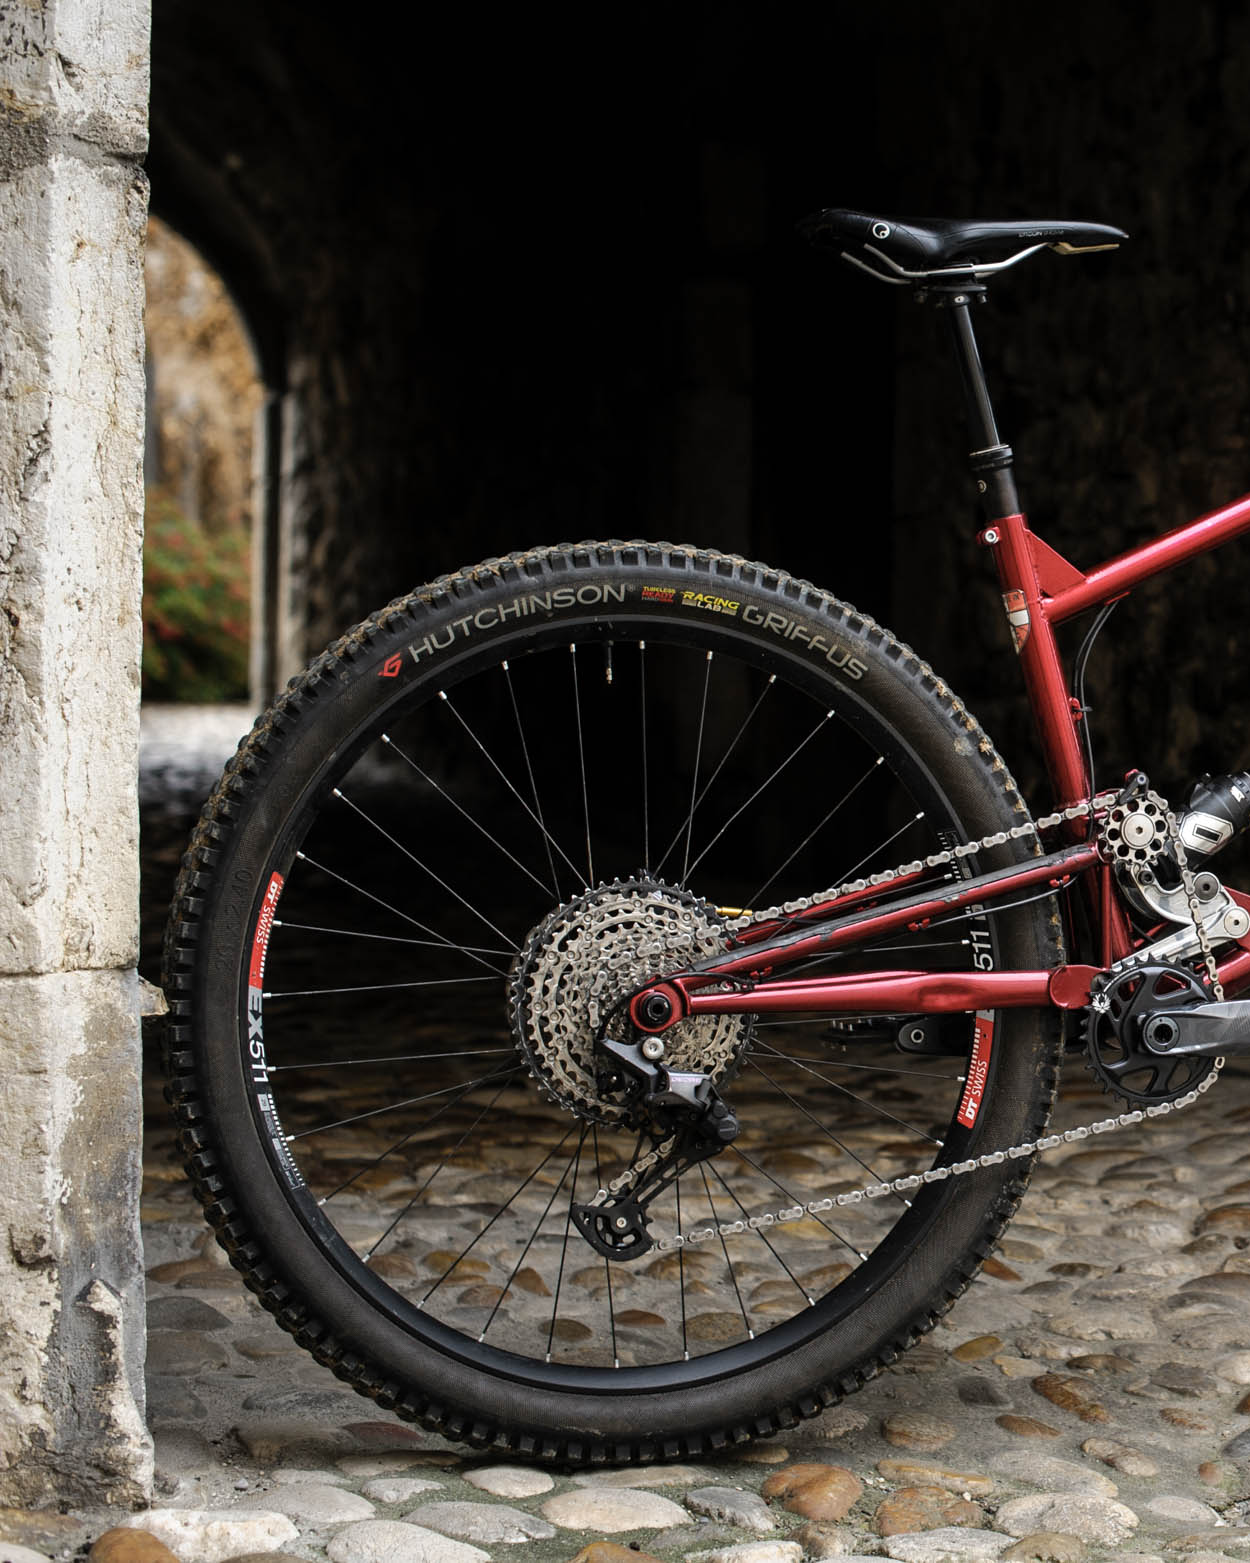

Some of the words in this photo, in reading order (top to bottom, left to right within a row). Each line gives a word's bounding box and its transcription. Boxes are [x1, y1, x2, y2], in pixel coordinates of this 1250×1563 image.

[681, 591, 740, 610] RACING
[697, 601, 722, 612] LAB
[408, 584, 626, 663] HUTCHINSON
[267, 880, 279, 904] DT
[256, 905, 271, 944] SWISS
[971, 1060, 987, 1096] SWISS
[965, 1098, 978, 1120] DT
